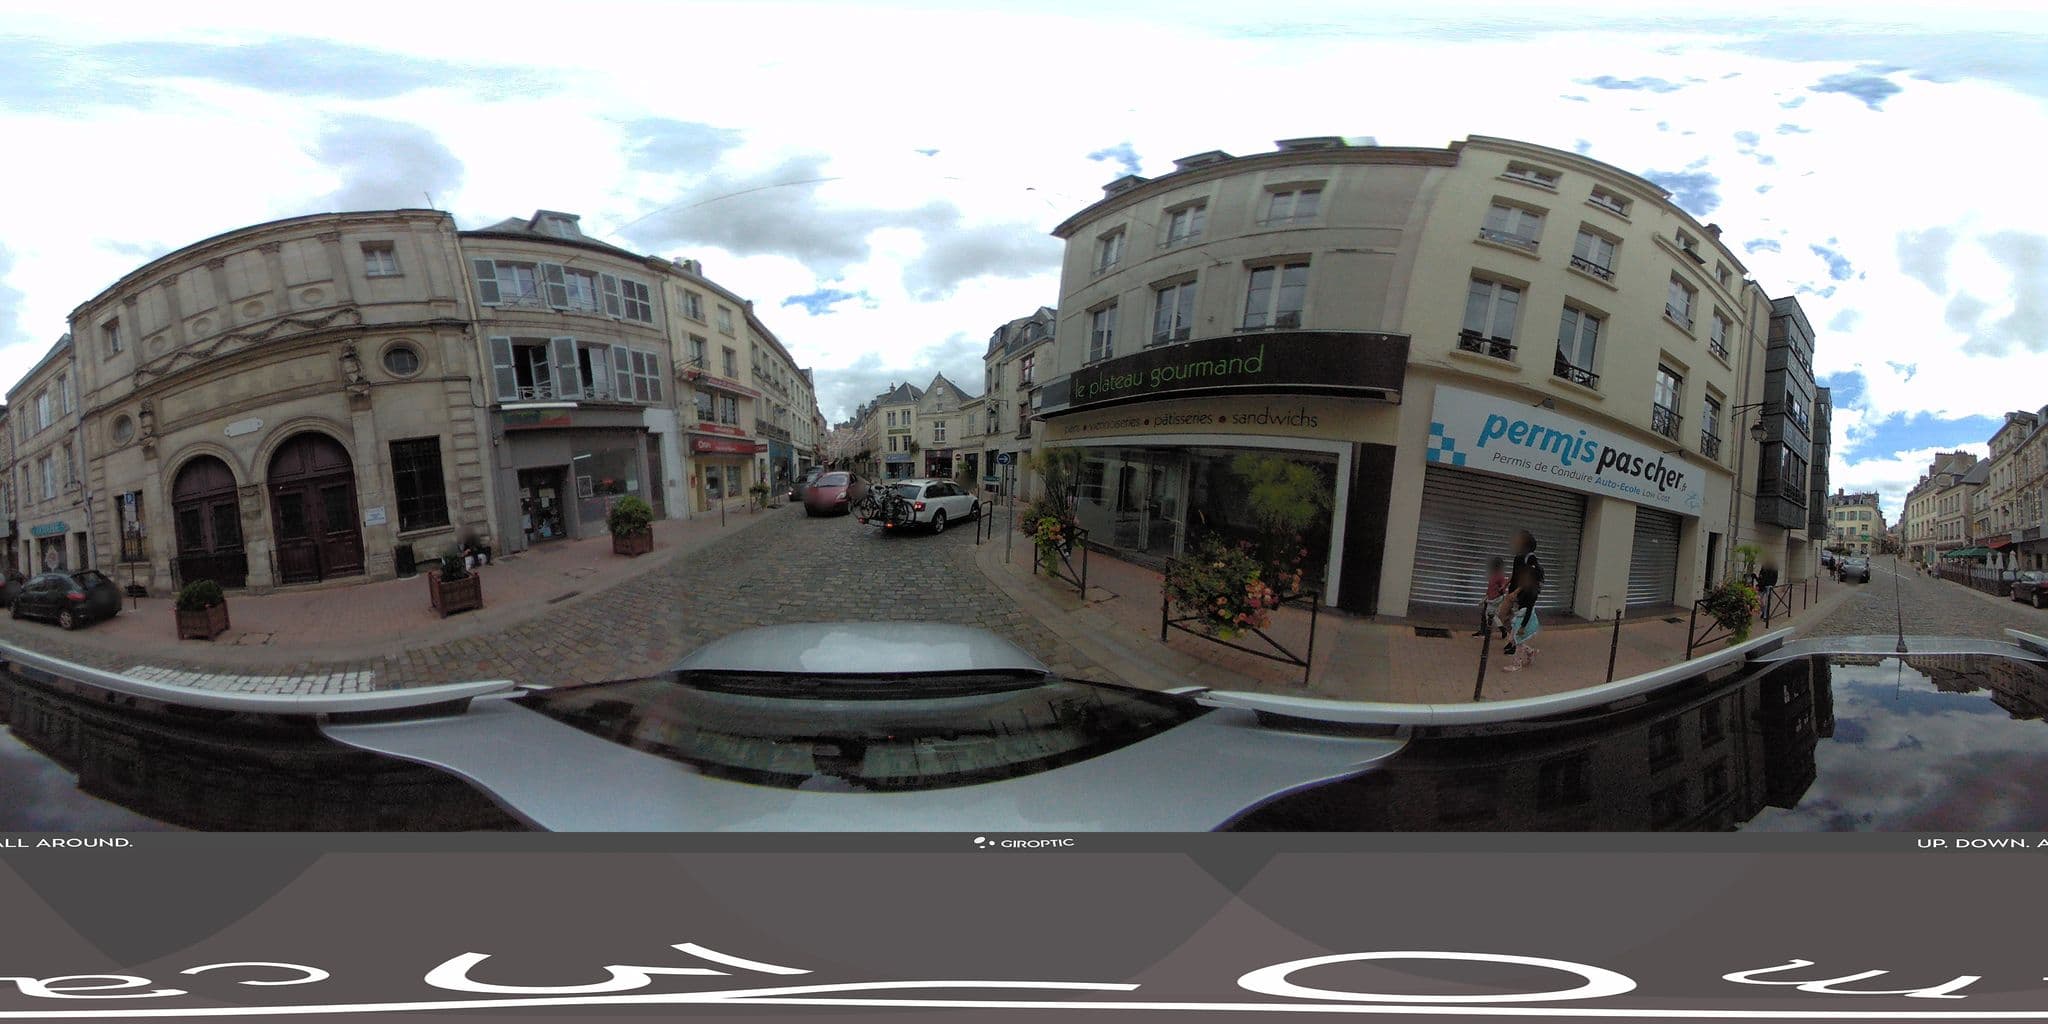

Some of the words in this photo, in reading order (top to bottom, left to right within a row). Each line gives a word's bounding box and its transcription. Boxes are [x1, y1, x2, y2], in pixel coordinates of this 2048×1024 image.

[1074, 378, 1085, 398] le
[1089, 371, 1143, 397] plateau
[1150, 343, 1265, 388] gourmand
[1153, 411, 1213, 428] pâtisseries
[1232, 407, 1318, 428] sandwichs
[1492, 452, 1531, 469] Permis
[1534, 461, 1548, 473] de
[1551, 465, 1593, 483] Conduire
[1642, 489, 1656, 499] Low
[1656, 491, 1671, 503] Cost
